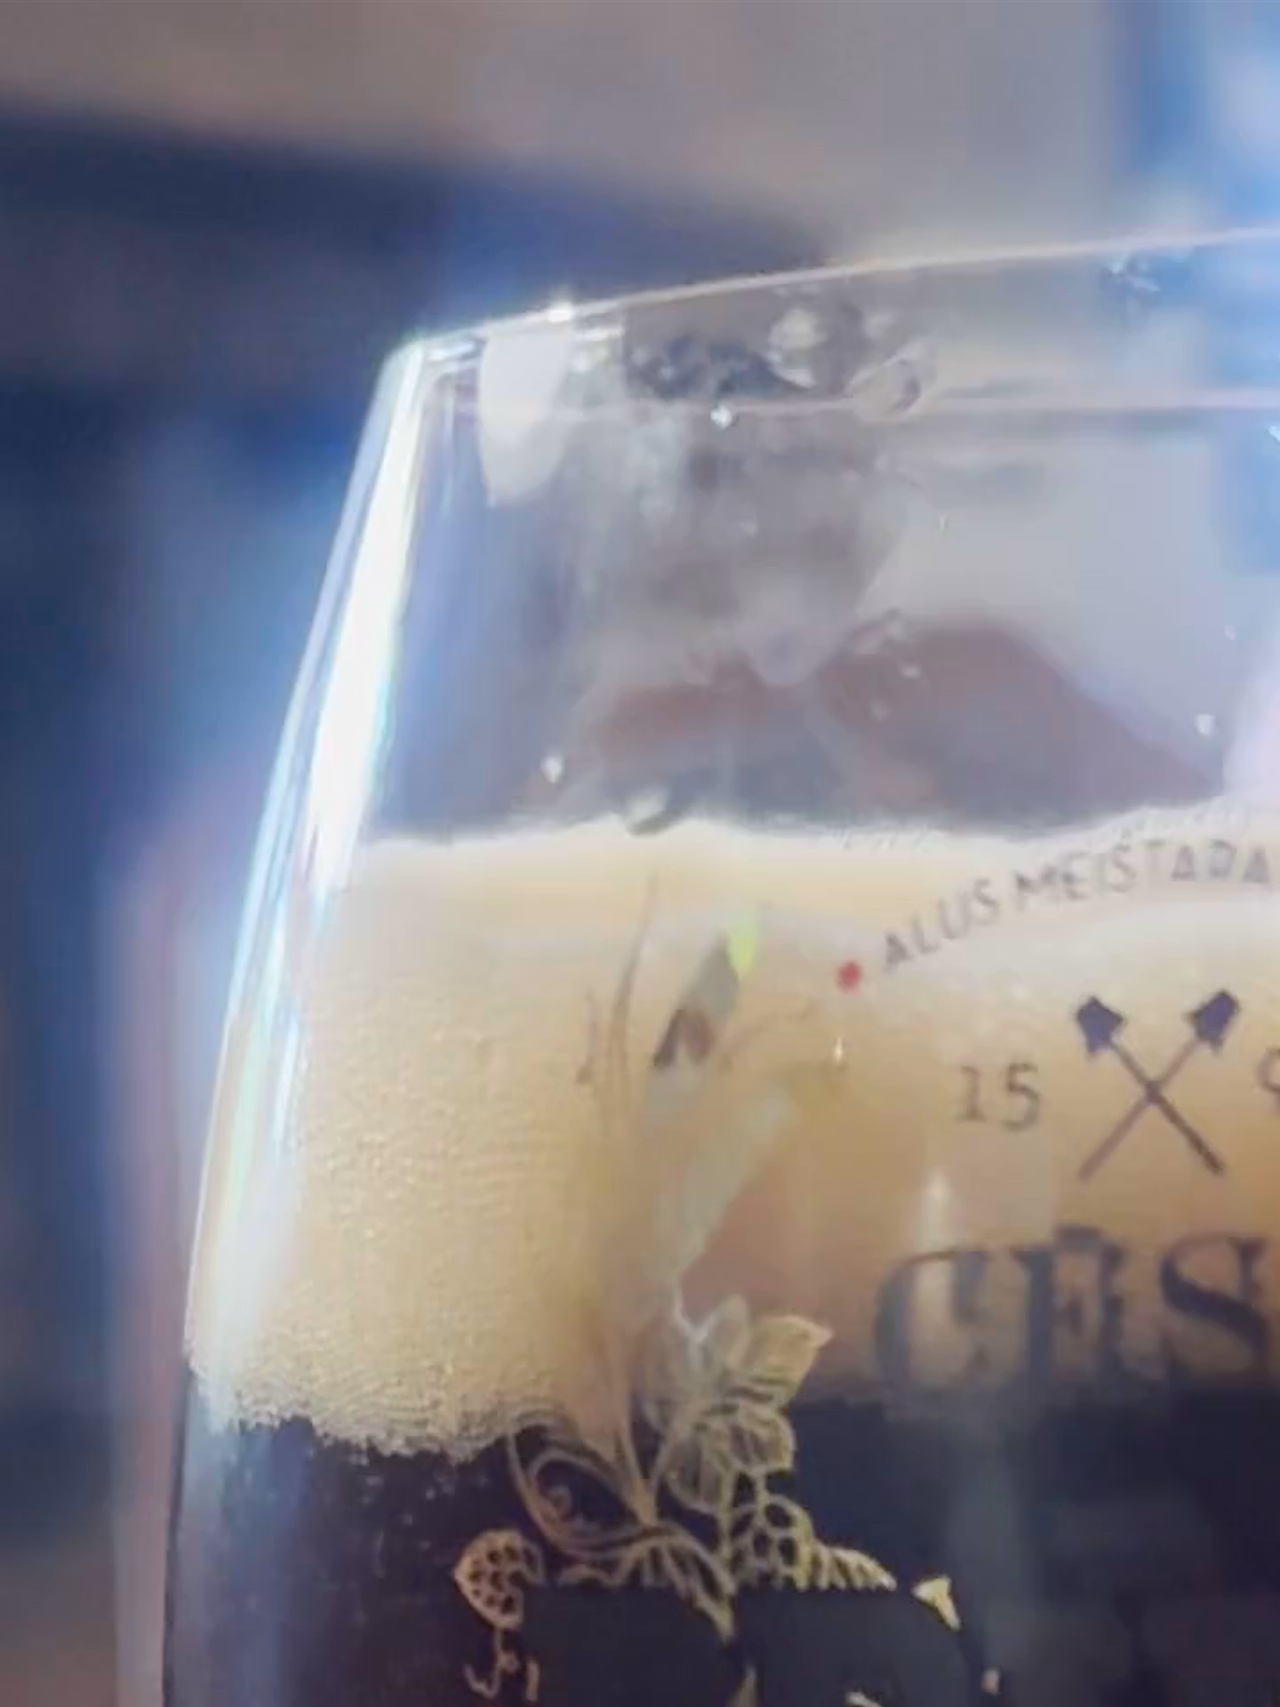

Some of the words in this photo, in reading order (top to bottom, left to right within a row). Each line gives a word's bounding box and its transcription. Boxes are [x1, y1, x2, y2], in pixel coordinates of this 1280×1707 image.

[883, 880, 1001, 971] ALUS
[1014, 838, 1272, 904] MEISTARA
[958, 1062, 1042, 1130] 15
